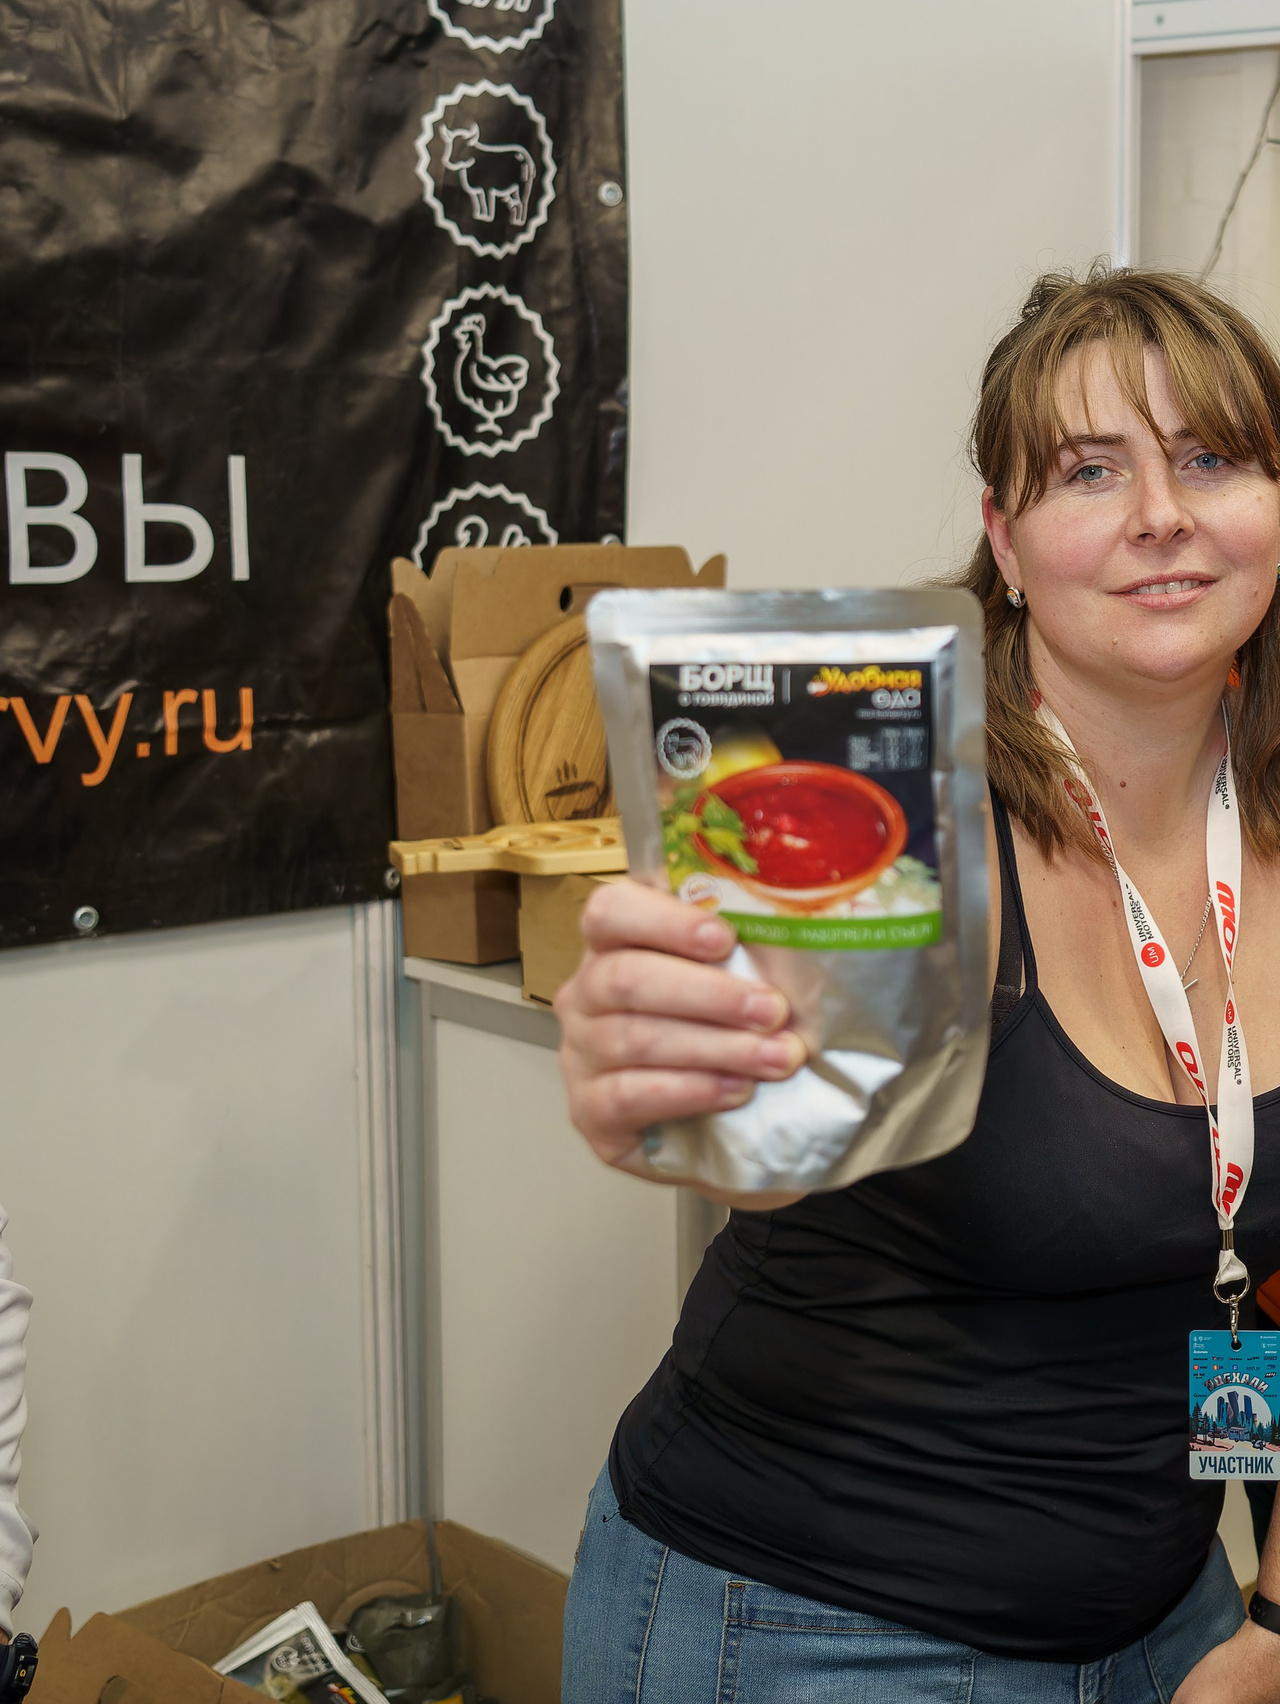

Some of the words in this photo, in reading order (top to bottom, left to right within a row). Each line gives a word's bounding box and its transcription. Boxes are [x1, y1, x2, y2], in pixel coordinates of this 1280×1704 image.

[5, 451, 250, 584] ВЫ
[679, 664, 775, 692] БОРЩ
[1199, 1456, 1275, 1474] УЧАСТНИК
